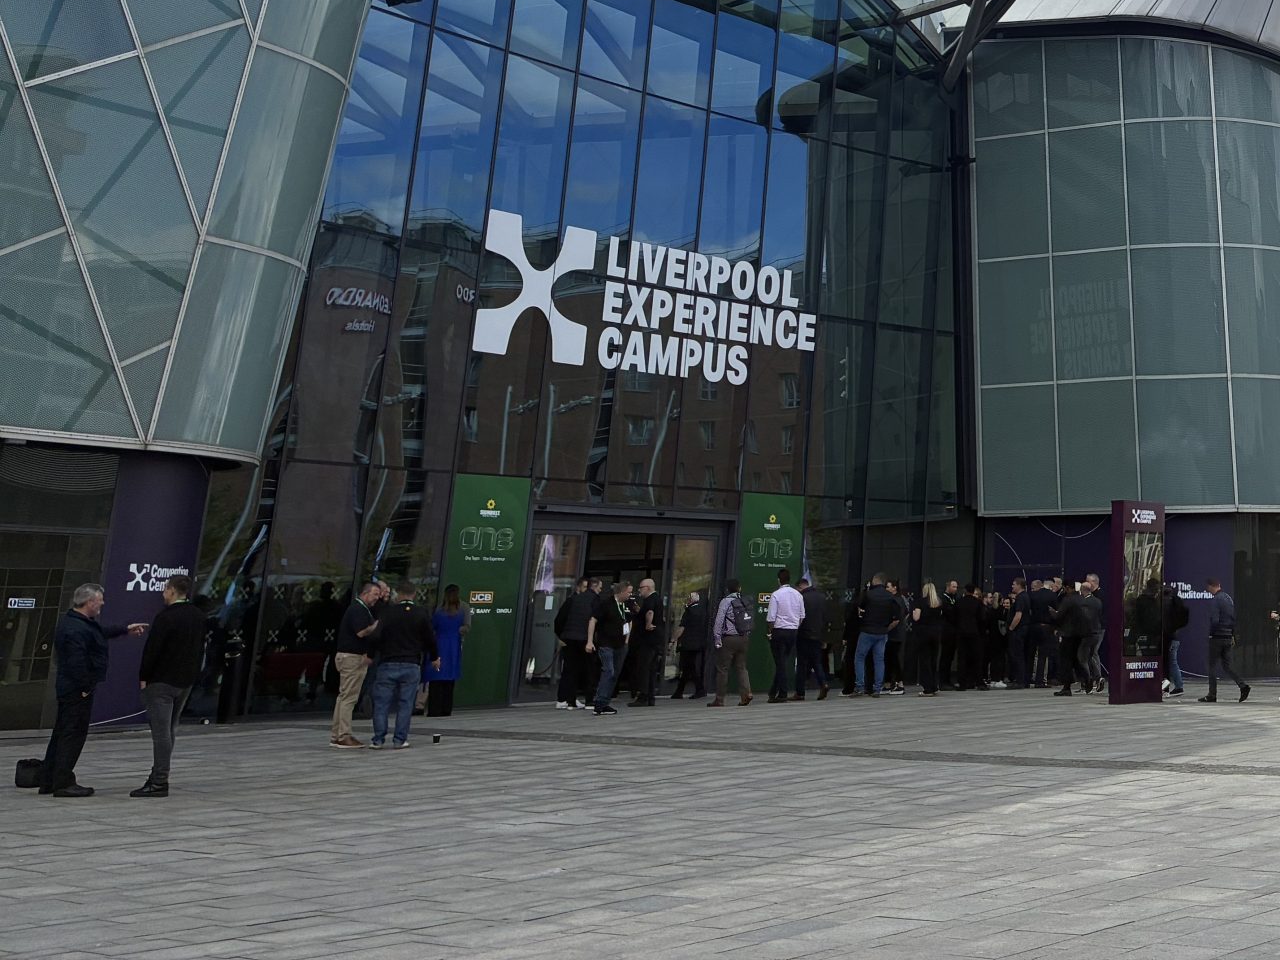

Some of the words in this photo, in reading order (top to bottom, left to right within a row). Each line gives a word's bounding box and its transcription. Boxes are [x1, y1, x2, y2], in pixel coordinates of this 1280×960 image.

[606, 235, 799, 308] LIVERPOOL
[602, 280, 816, 351] EXPERIENCE
[597, 326, 748, 386] CAMPUS
[471, 593, 492, 601] JCB
[760, 594, 771, 602] JC
[1177, 581, 1192, 591] The
